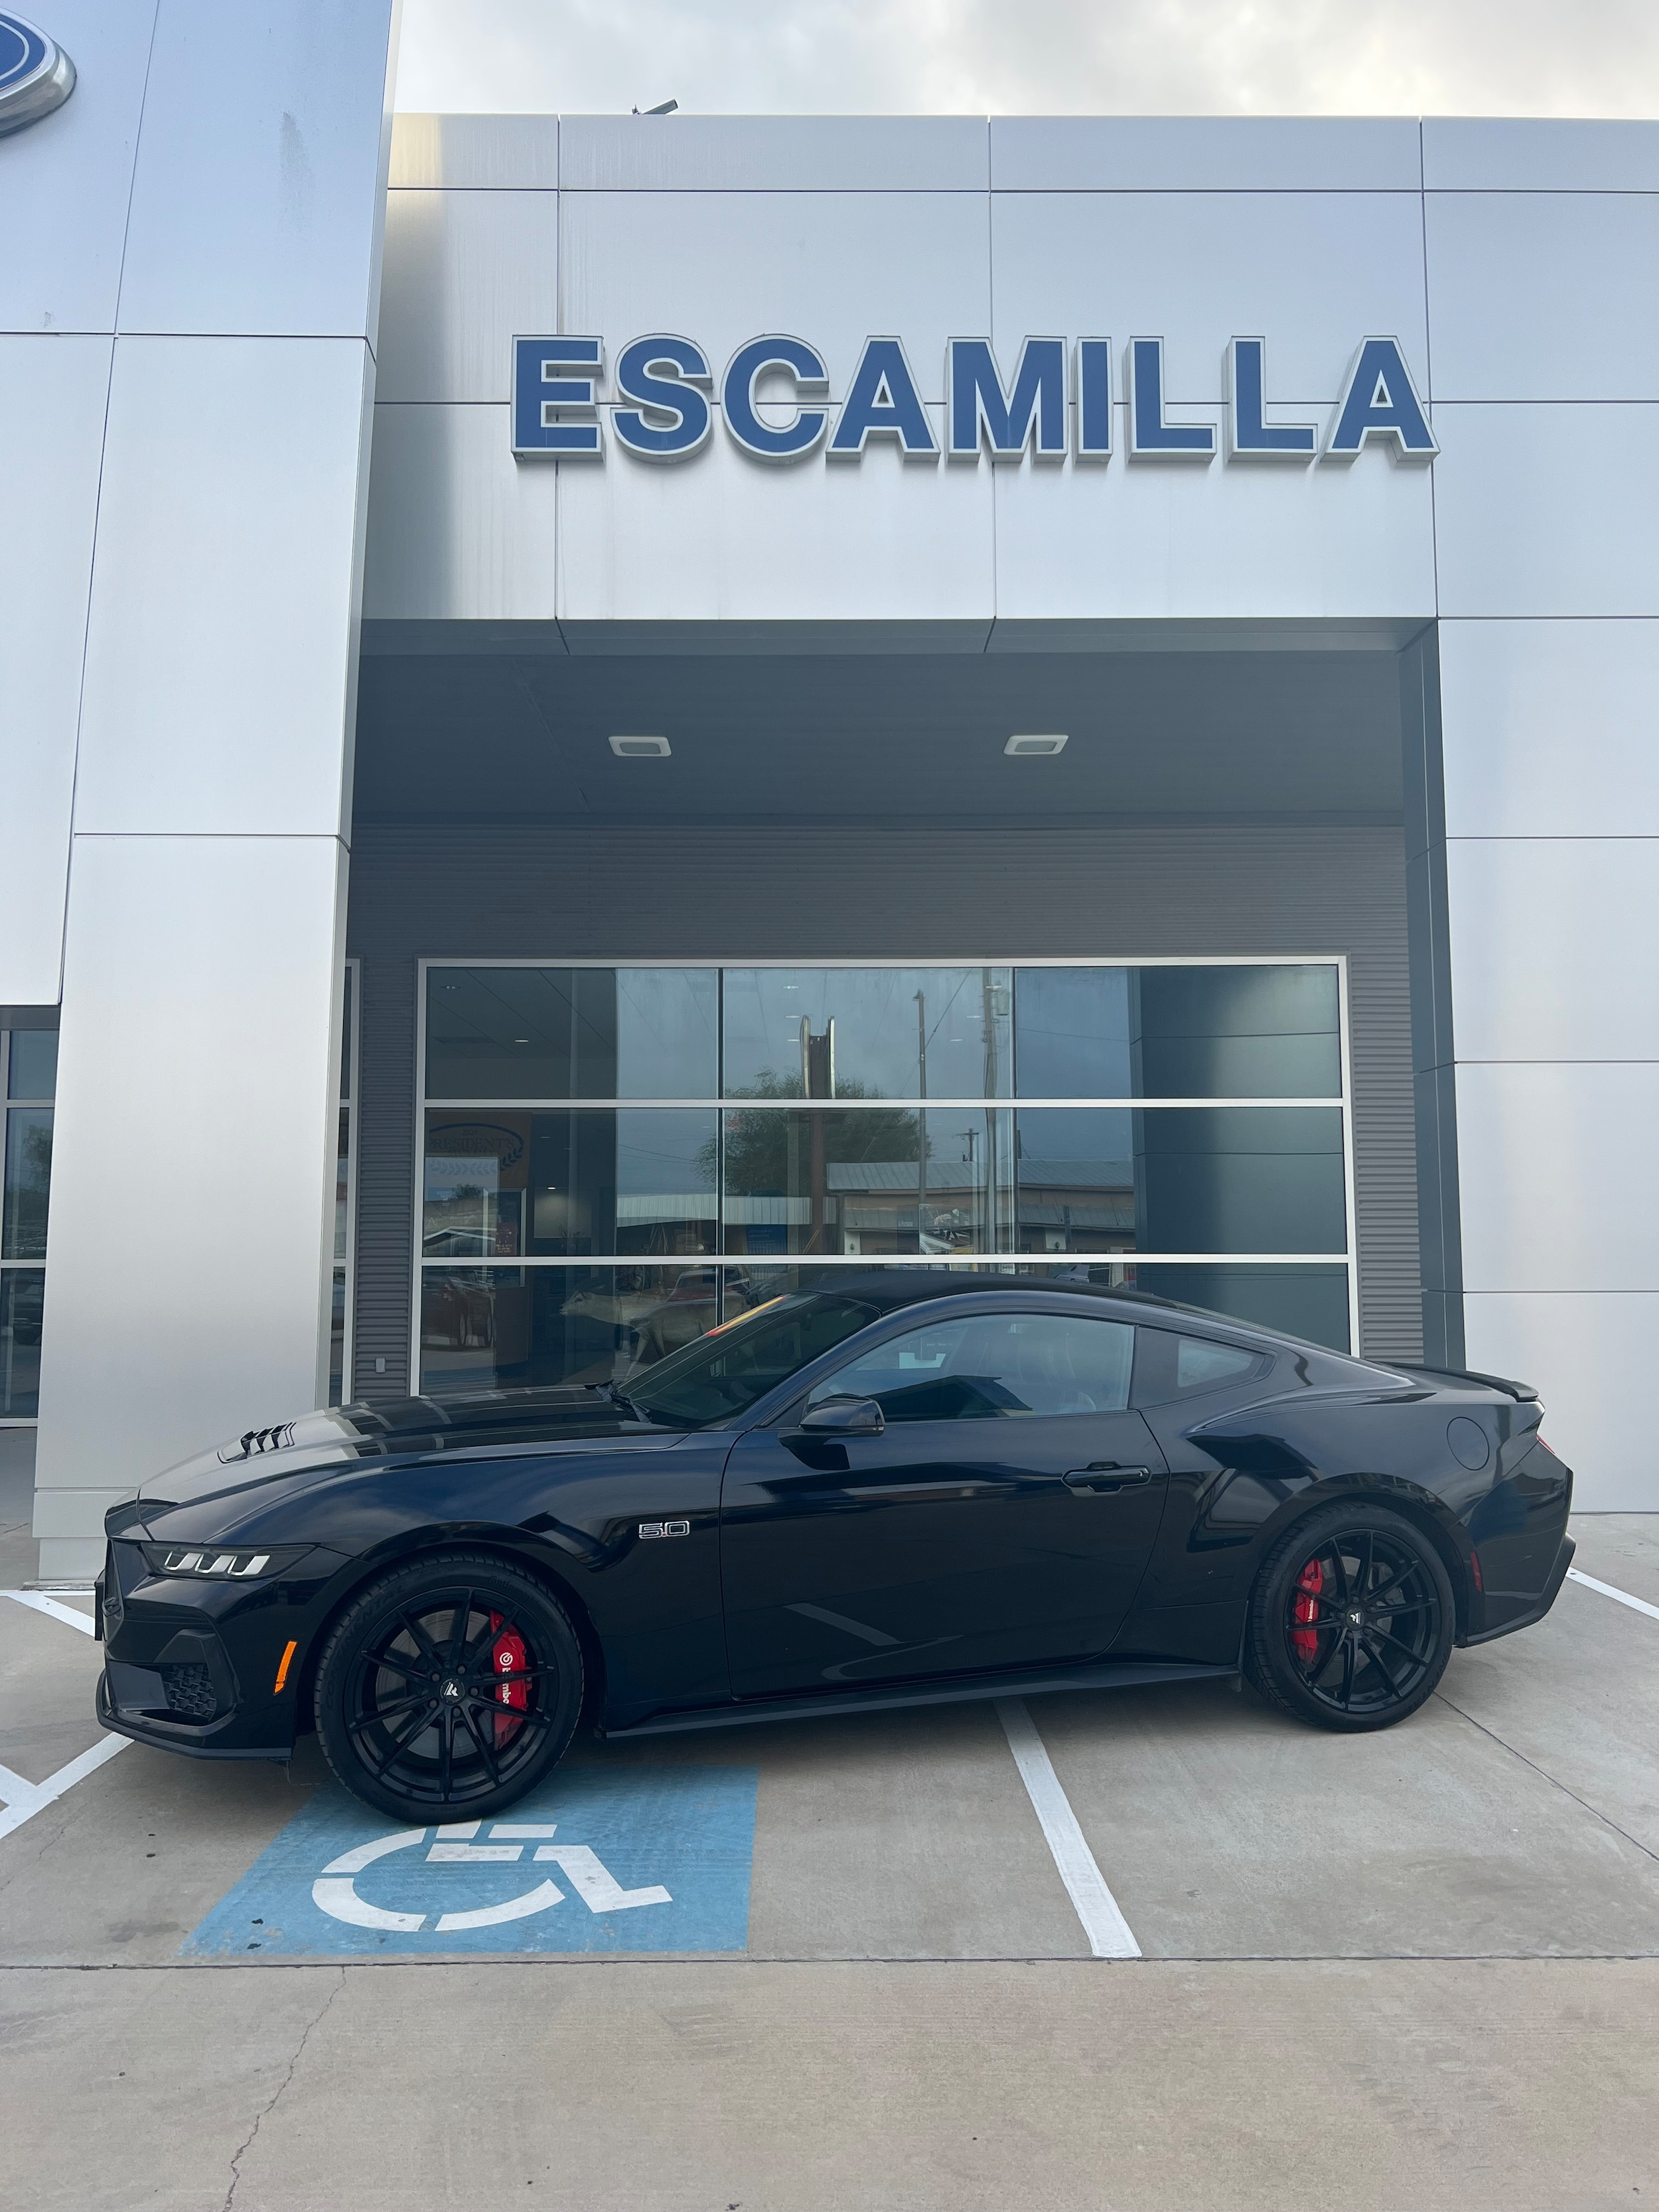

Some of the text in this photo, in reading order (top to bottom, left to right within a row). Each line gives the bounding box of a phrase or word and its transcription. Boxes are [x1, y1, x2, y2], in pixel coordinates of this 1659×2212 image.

[511, 334, 1439, 462] ESCAMILLA
[638, 1520, 690, 1539] 5.0
[502, 1667, 512, 1704] bmbo
